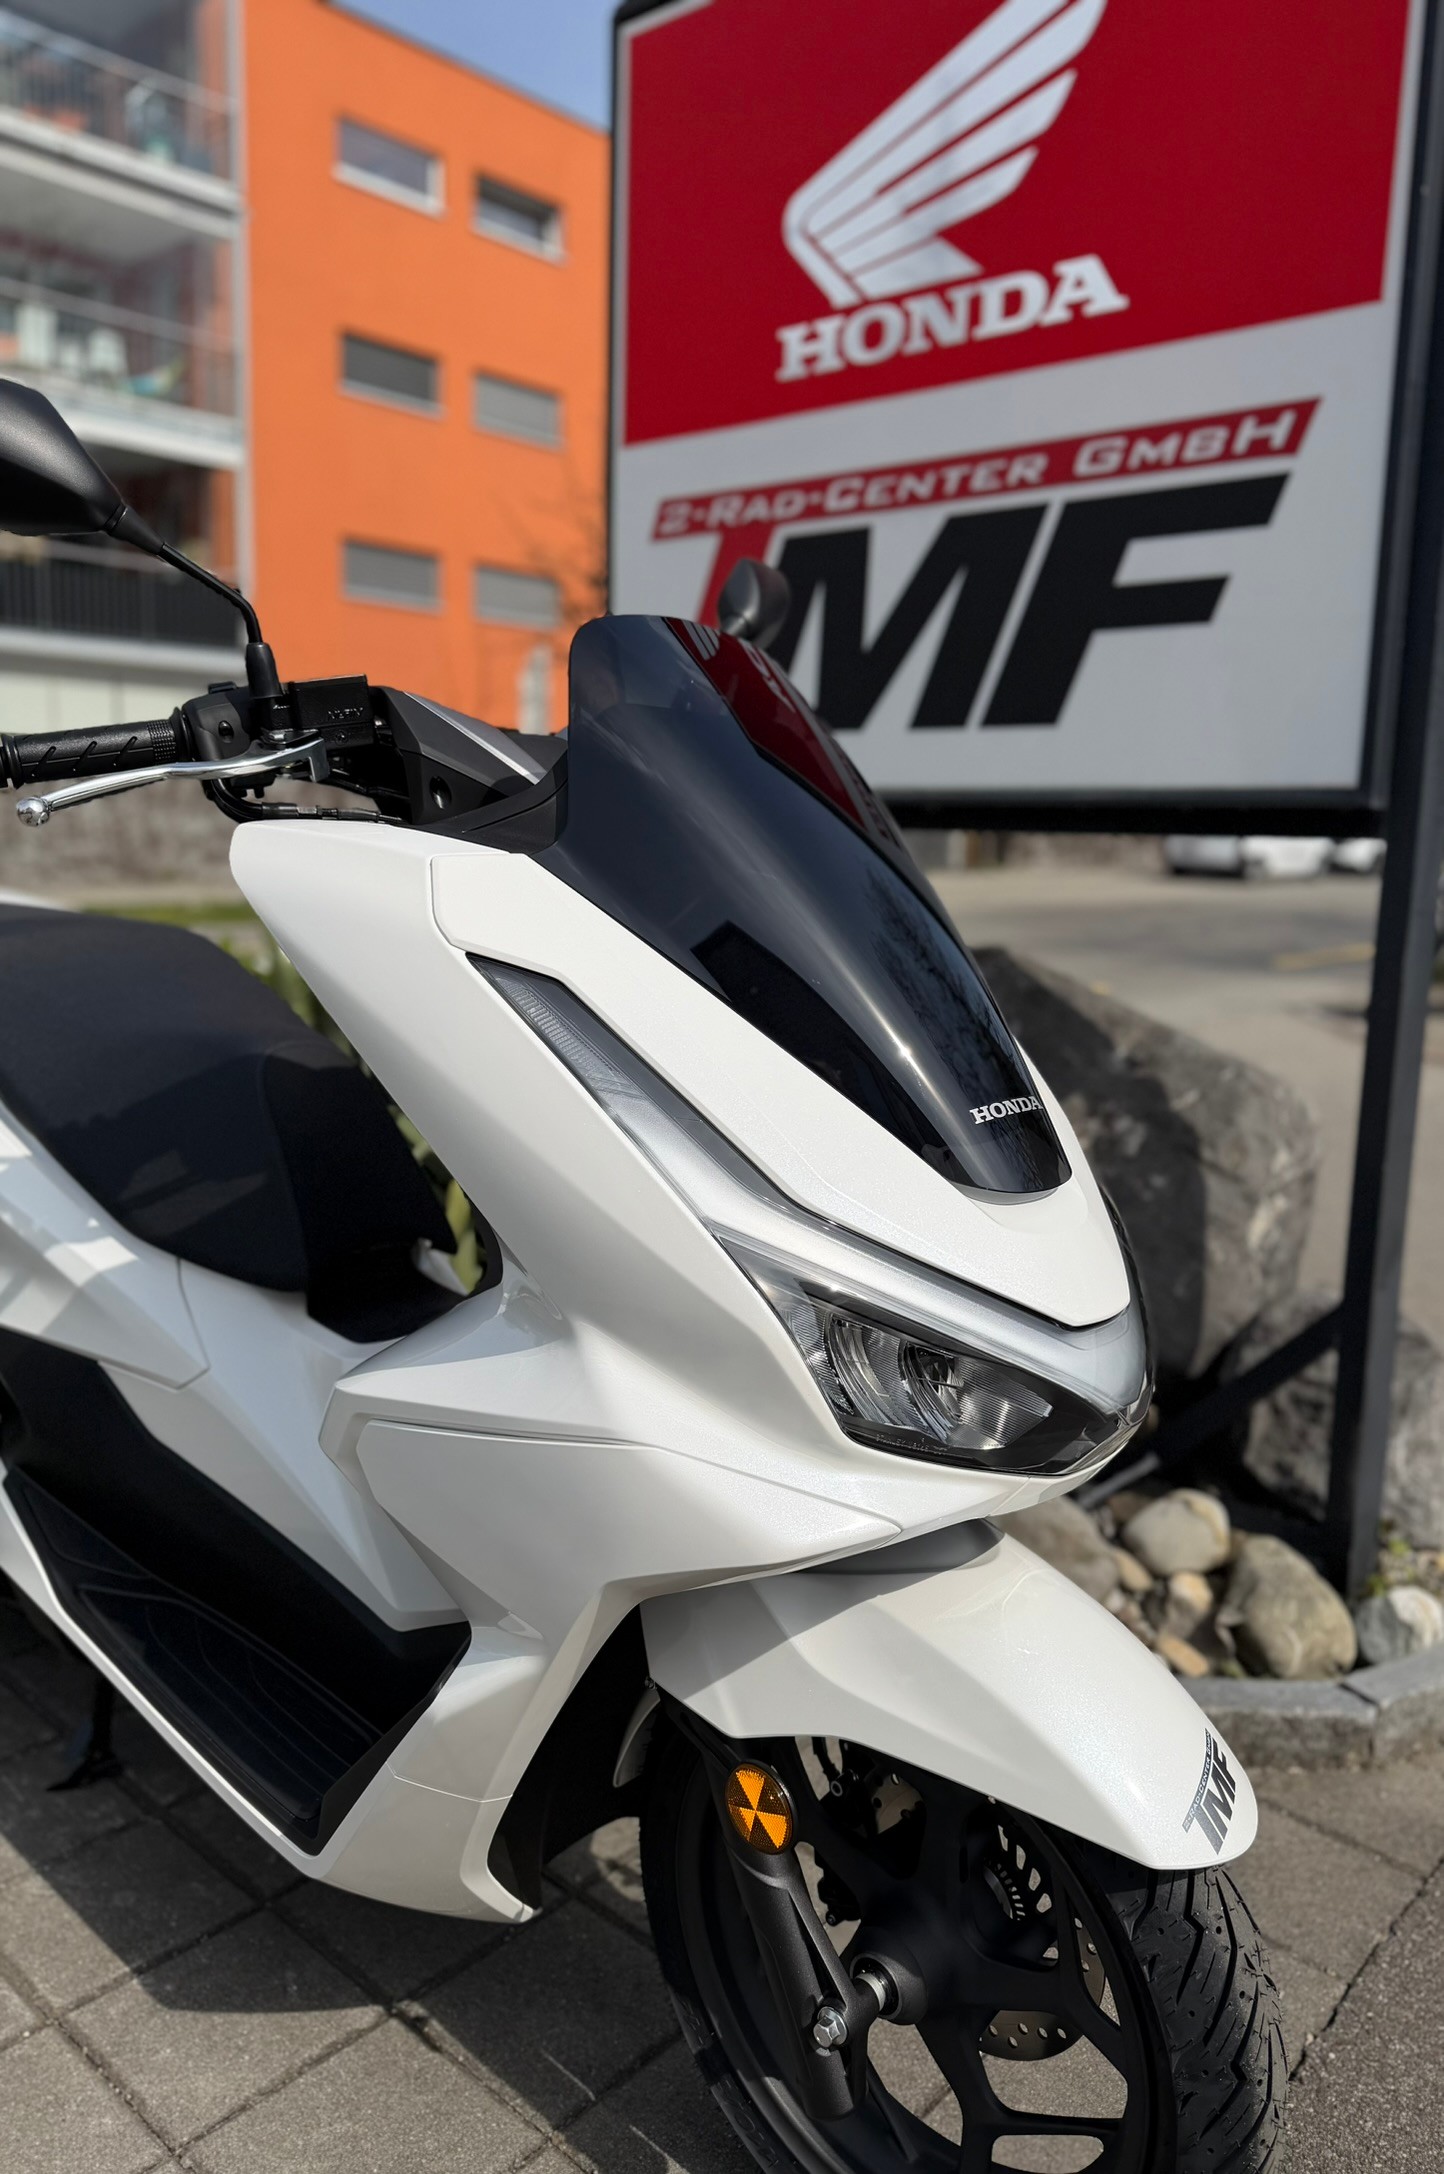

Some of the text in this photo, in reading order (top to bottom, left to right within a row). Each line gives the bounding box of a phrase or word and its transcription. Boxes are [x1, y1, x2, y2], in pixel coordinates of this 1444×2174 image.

[777, 254, 1129, 382] HONDA
[969, 1096, 1043, 1124] HONDA
[1184, 1737, 1236, 1856] TMF
